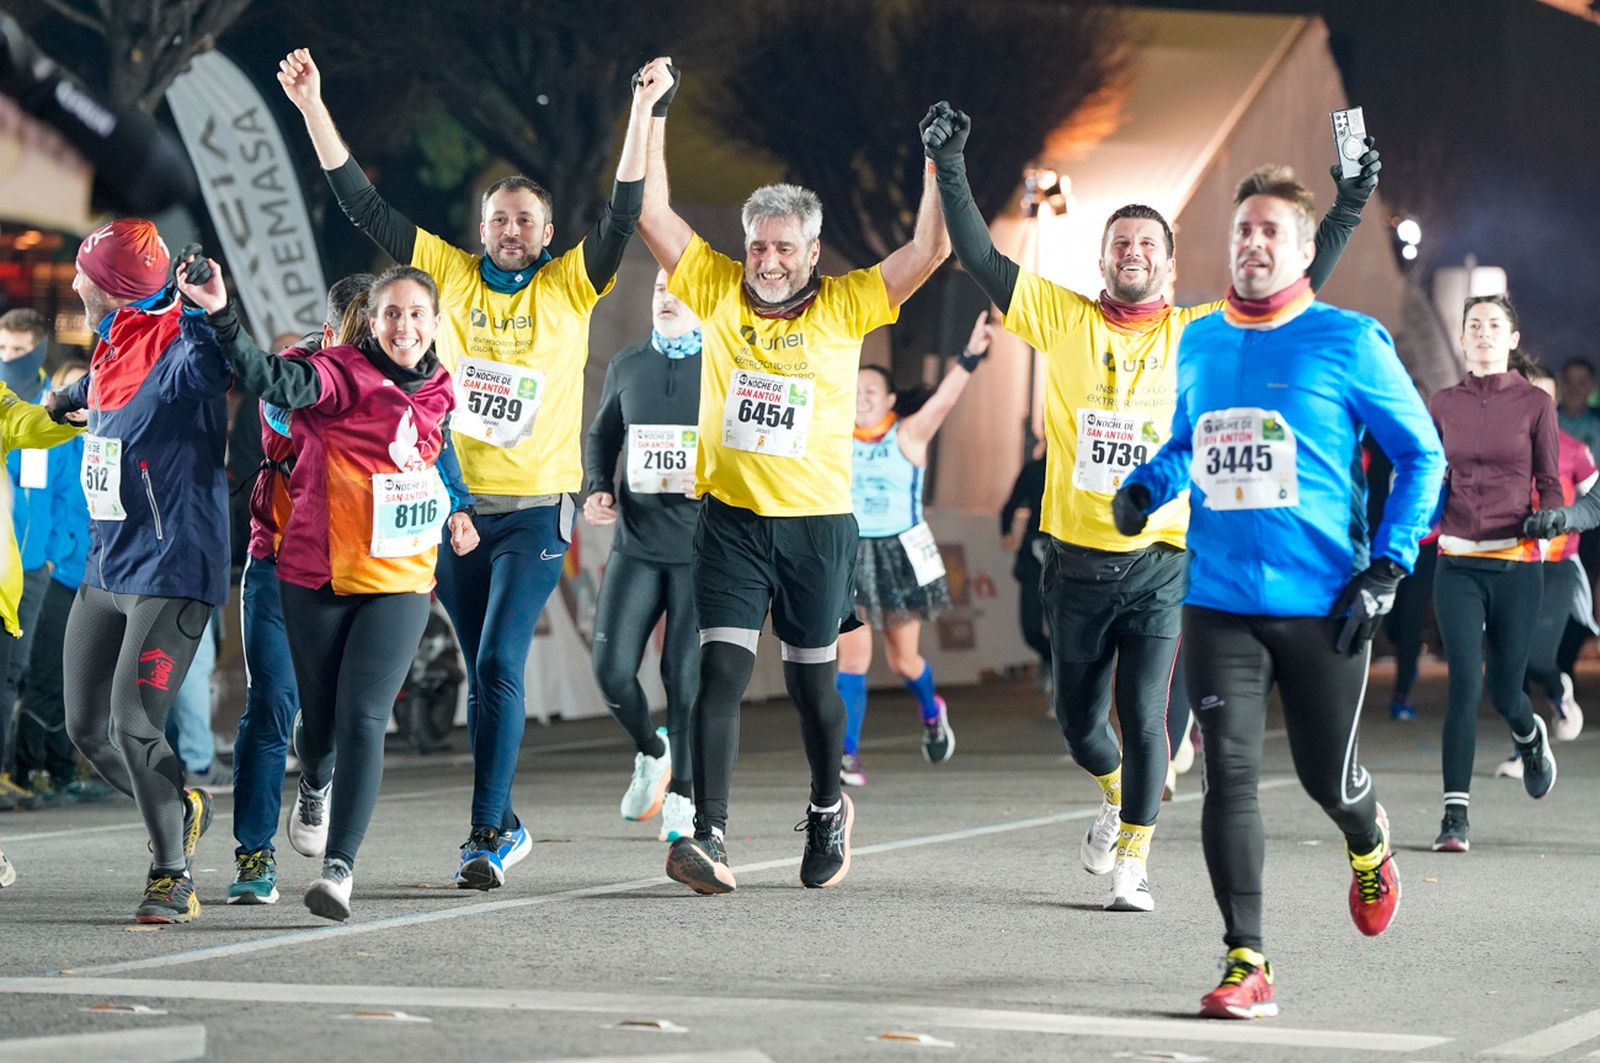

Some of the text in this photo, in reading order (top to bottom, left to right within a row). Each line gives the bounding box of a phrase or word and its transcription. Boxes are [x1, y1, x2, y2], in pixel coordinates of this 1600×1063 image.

[463, 379, 481, 390] SAN
[475, 372, 501, 384] NOCHE
[501, 376, 513, 386] DE
[747, 380, 784, 393] NOCHE DE
[736, 387, 753, 398] SAN
[468, 390, 523, 423] 5739
[738, 398, 796, 430] 6454
[1086, 427, 1104, 438] SAN
[1095, 419, 1122, 430] NOCHE
[1123, 422, 1135, 431] DE
[643, 450, 687, 470] 2163
[1091, 439, 1147, 468] 5739
[1206, 444, 1273, 476] 3445
[394, 498, 438, 529] 8116
